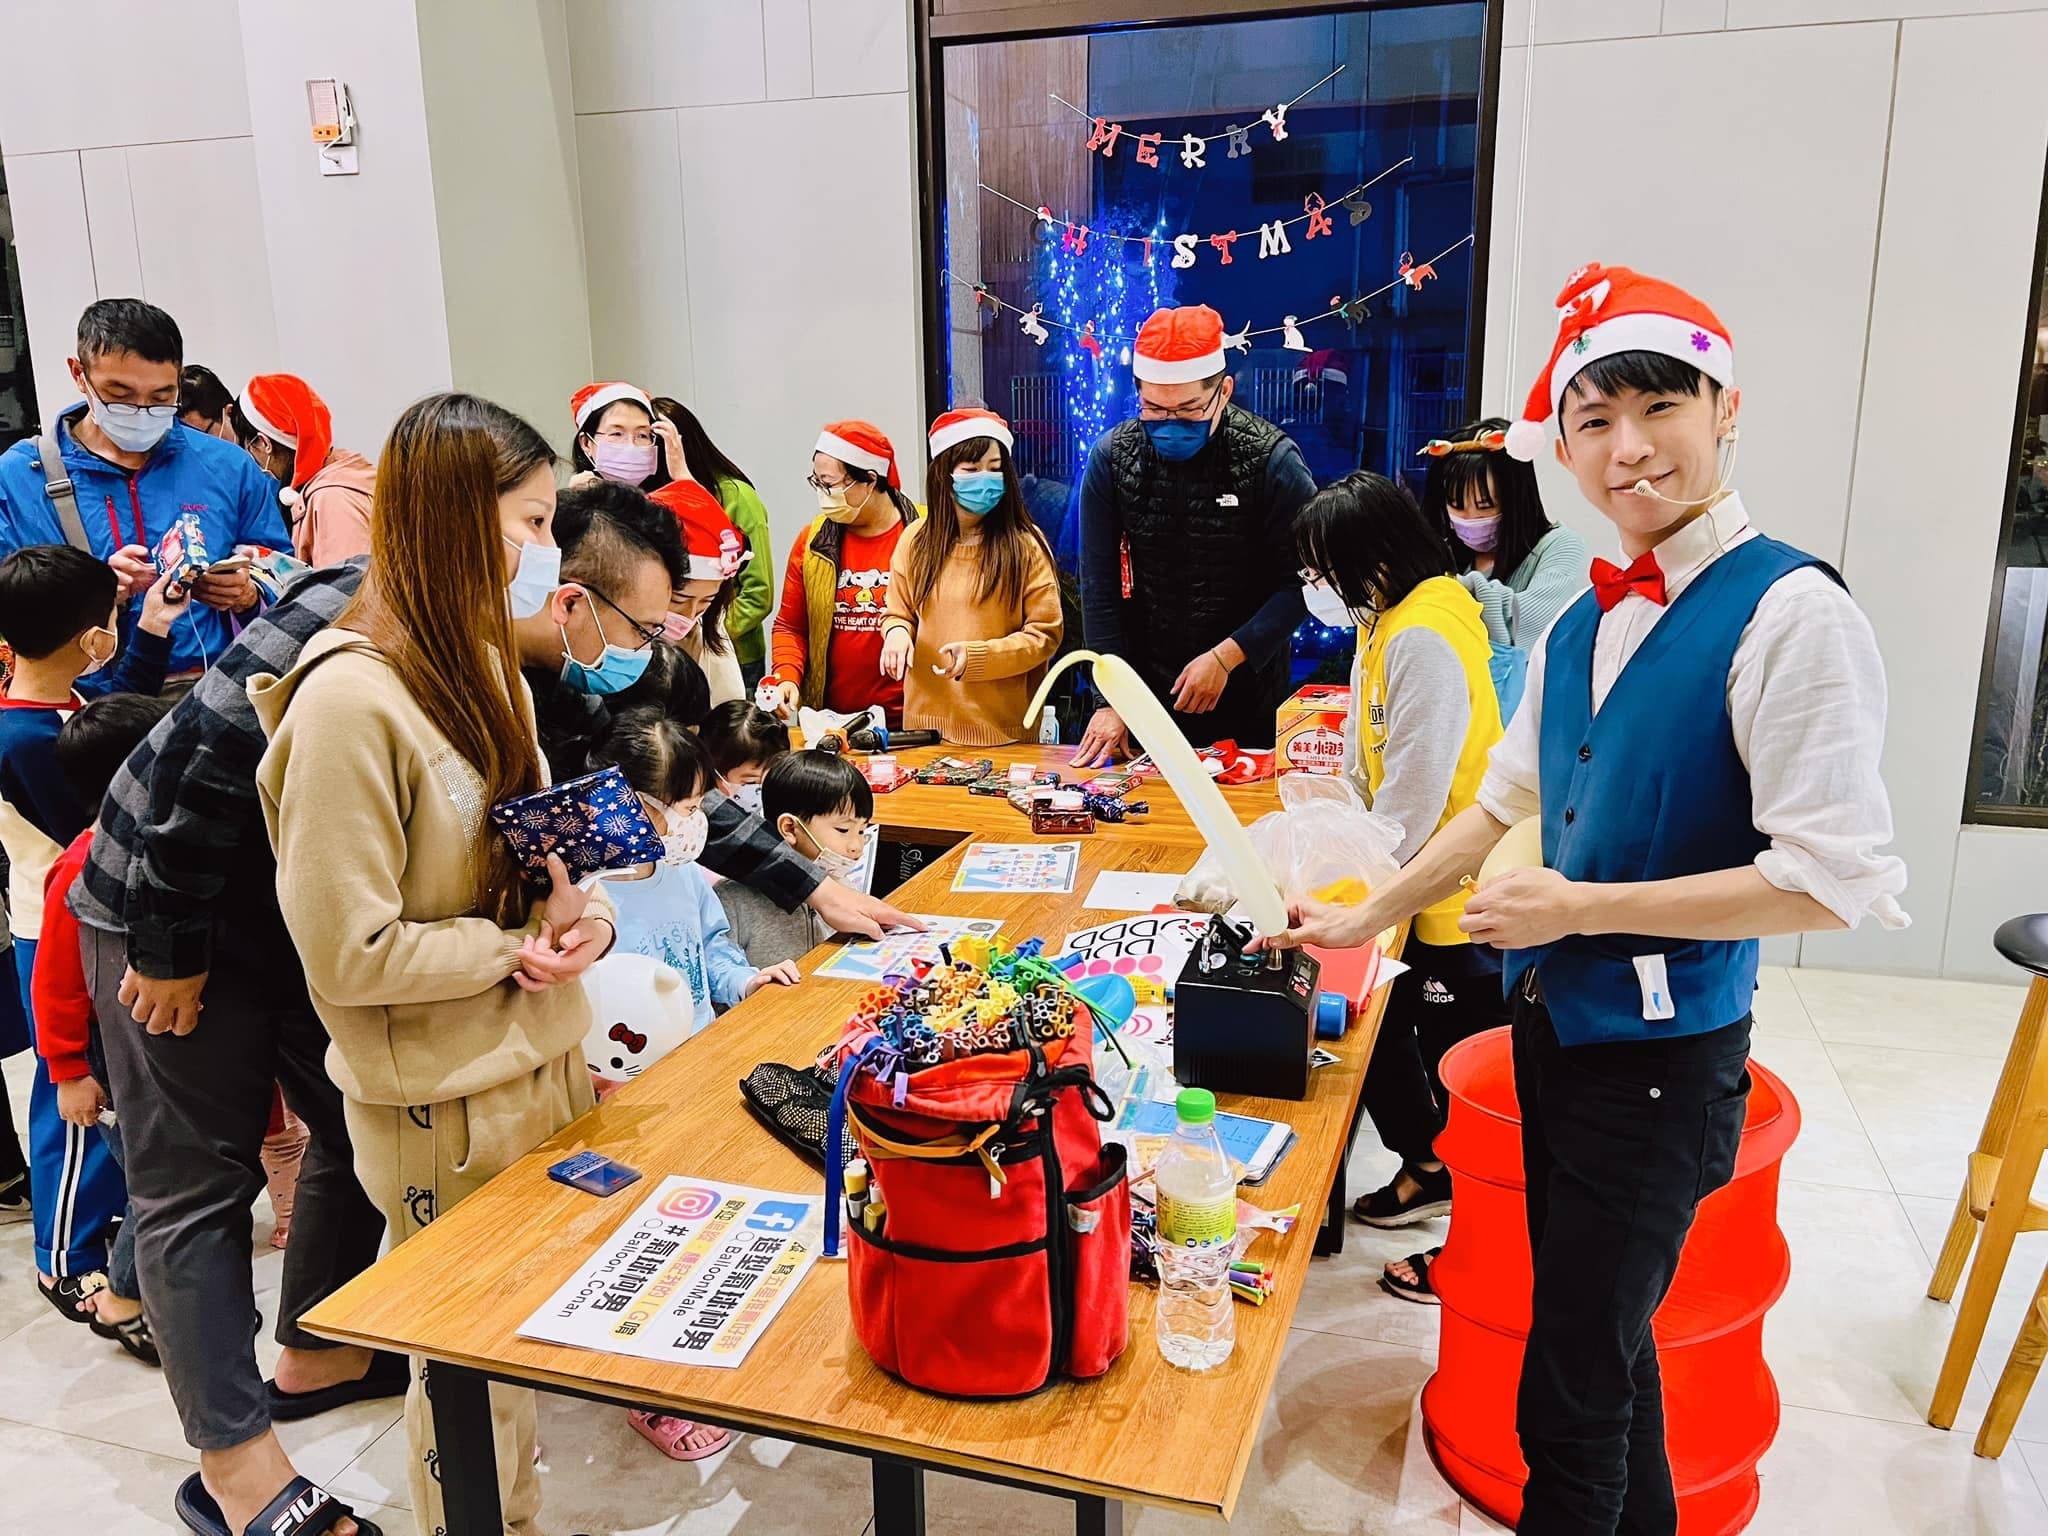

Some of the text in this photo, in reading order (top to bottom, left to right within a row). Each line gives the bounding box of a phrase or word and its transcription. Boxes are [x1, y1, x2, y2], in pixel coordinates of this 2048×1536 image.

[1086, 103, 1289, 168] MERRY
[1029, 185, 1372, 269] CHISTMAS
[556, 1231, 652, 1318] Balloon_Conan
[670, 1245, 743, 1317] BalloonMale
[670, 1235, 786, 1351] 造型氣球柯男
[271, 1487, 330, 1536] FILA
